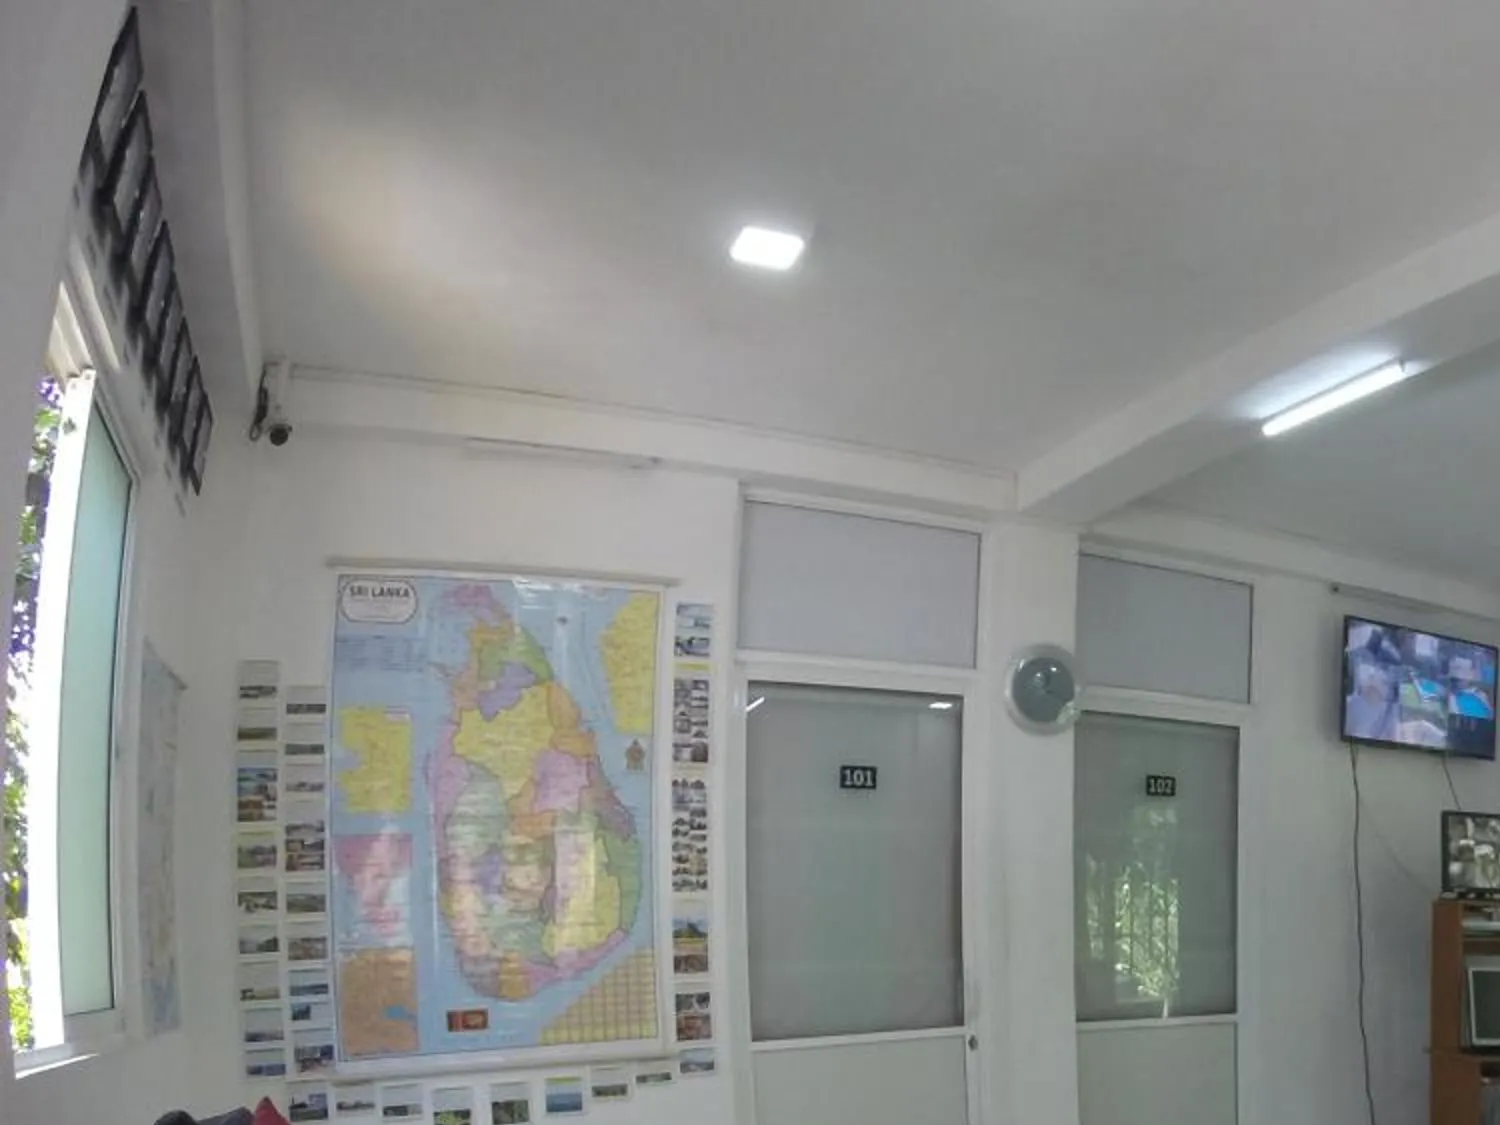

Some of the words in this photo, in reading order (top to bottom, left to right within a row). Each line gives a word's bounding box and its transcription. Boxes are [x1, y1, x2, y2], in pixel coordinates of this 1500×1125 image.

[350, 585, 369, 597] SRI
[372, 586, 410, 598] LANKA
[844, 769, 874, 787] 101
